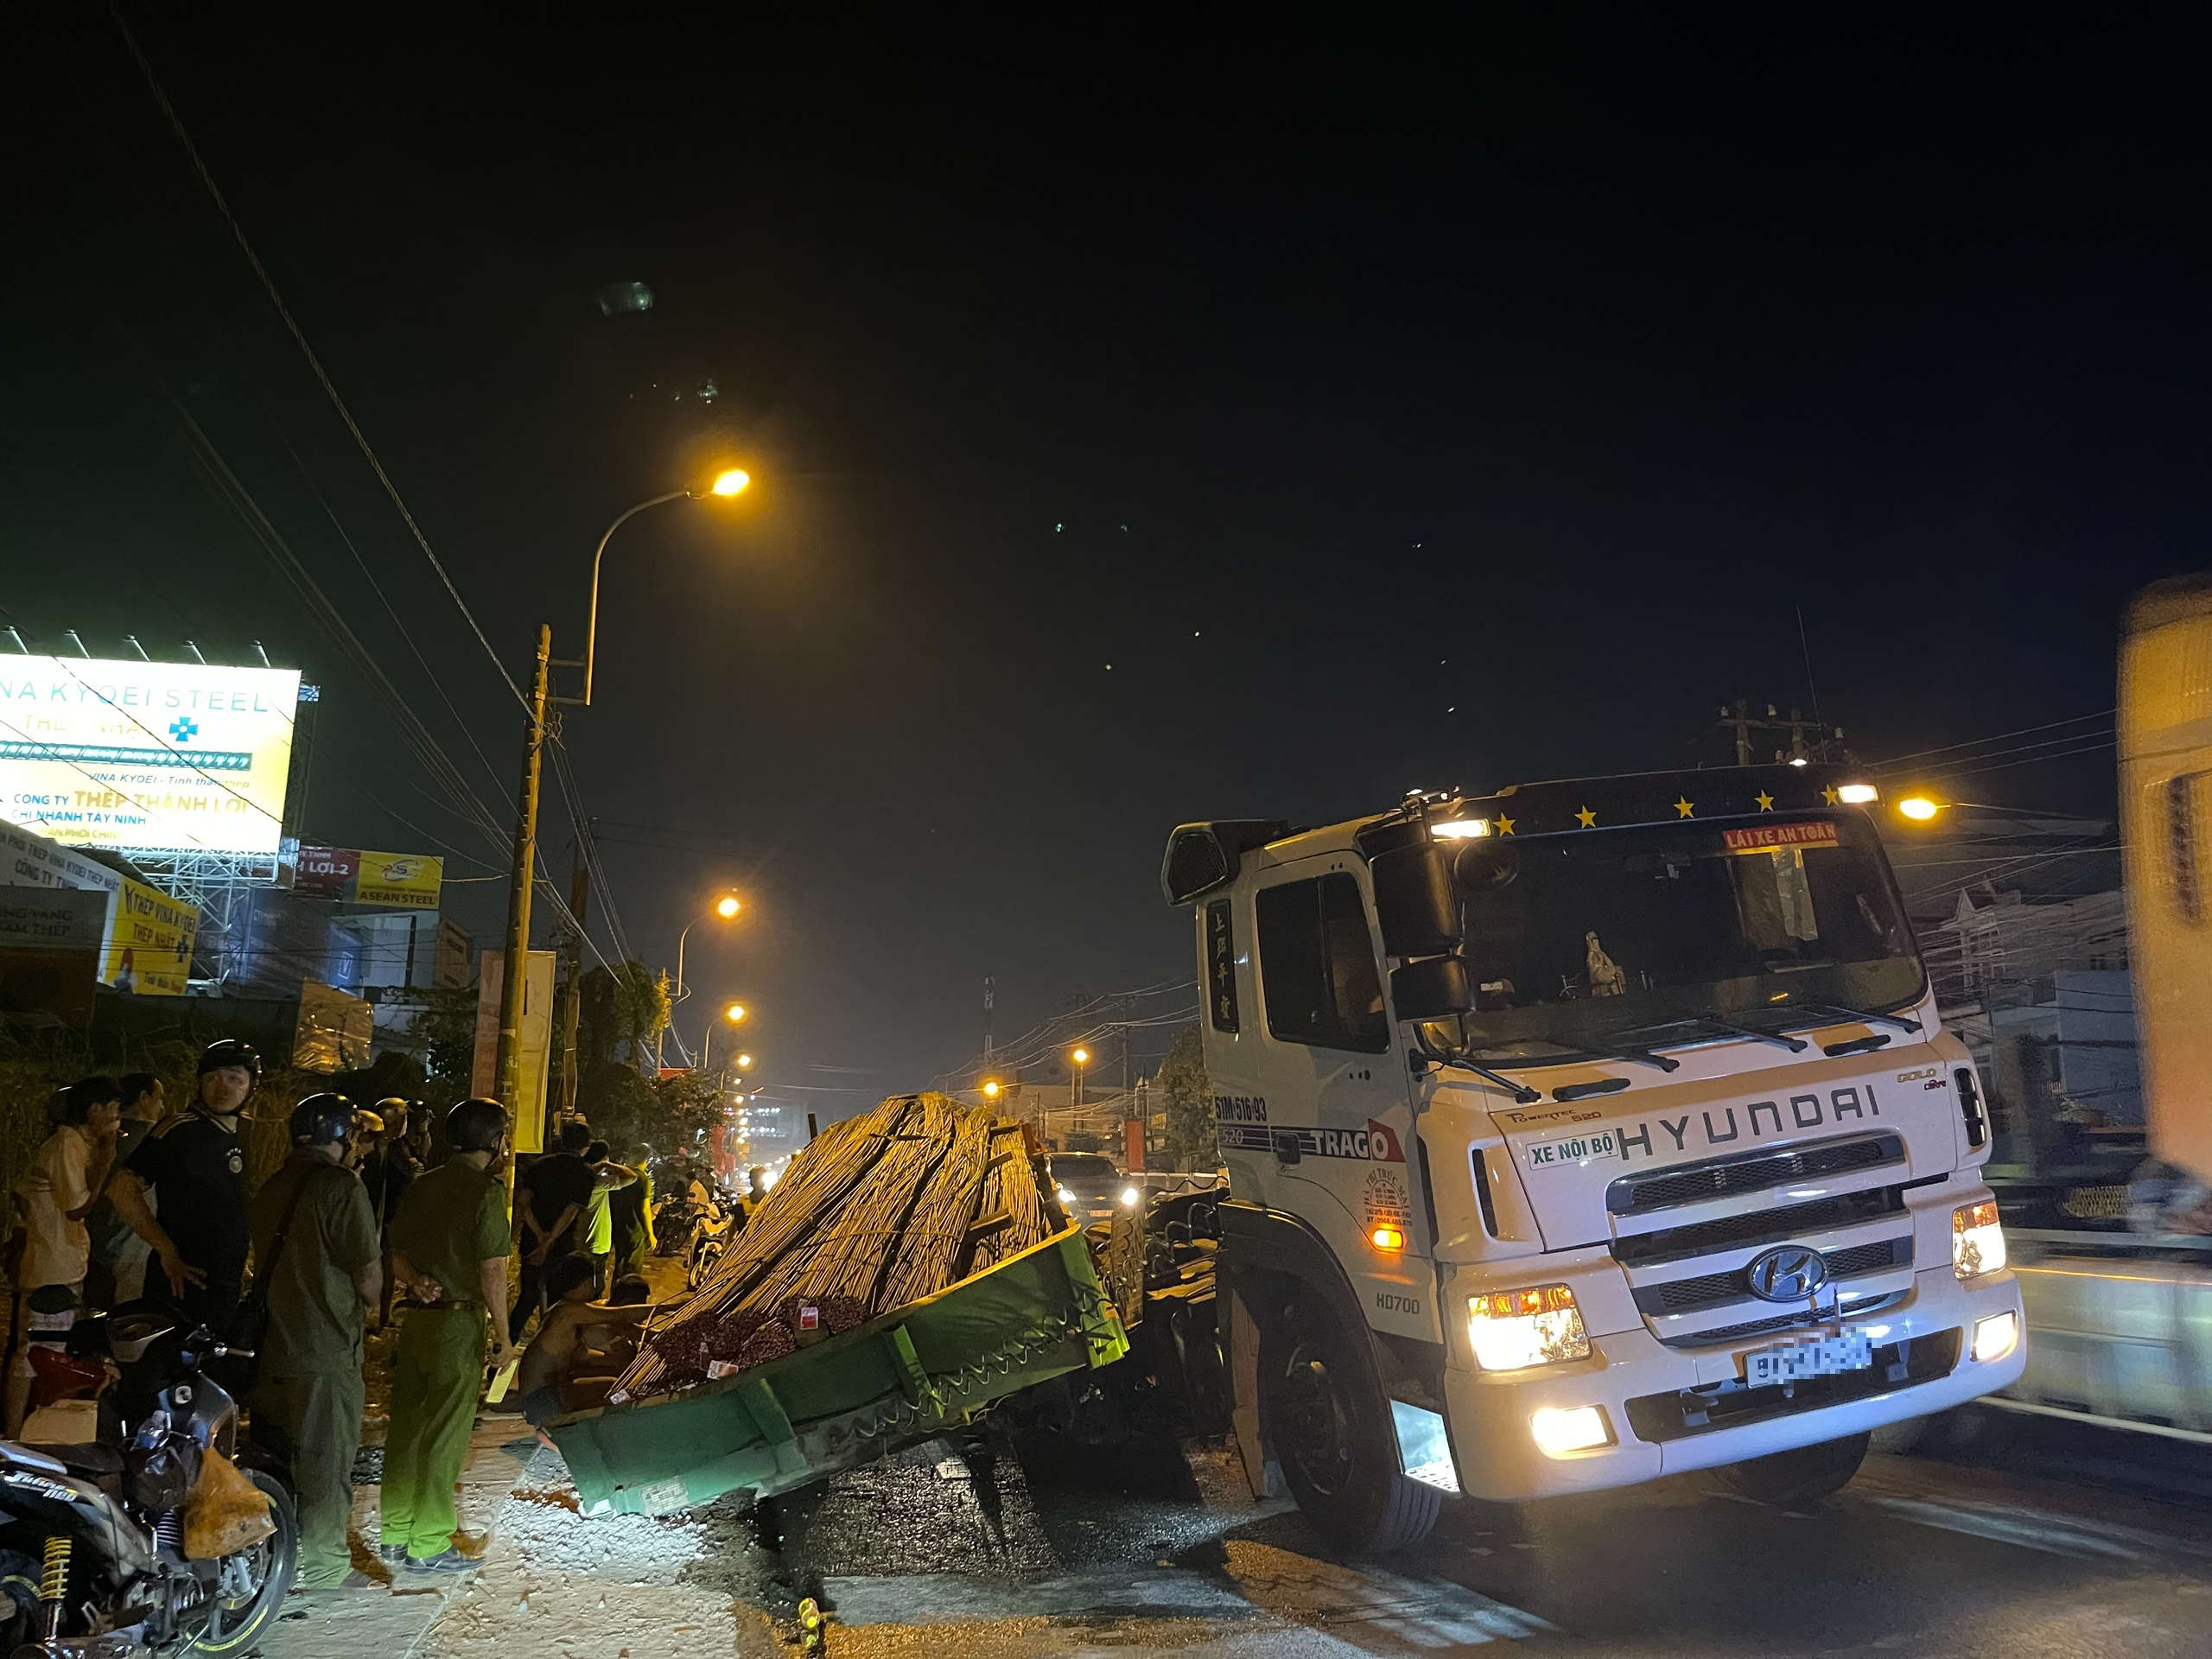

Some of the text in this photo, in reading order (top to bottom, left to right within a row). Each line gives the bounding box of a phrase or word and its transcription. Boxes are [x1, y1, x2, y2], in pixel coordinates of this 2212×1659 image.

[50, 681, 150, 707] KYOEI
[164, 689, 269, 713] STEEL
[89, 772, 117, 783] VINA
[119, 773, 157, 784] KYOEI
[54, 795, 69, 806] TY
[11, 809, 32, 819] CHI
[114, 814, 146, 825] NINH
[1727, 830, 1753, 849] LÁI
[1755, 830, 1776, 845] XE
[1777, 828, 1797, 842] AN
[42, 870, 54, 886] TY
[359, 891, 435, 906] ASEAN STEEL
[1571, 1110, 1602, 1122] 520
[1616, 1084, 1880, 1160] HYUNDAI
[1221, 1128, 1244, 1145] 520
[1309, 1129, 1389, 1160] TRAGO
[1531, 1133, 1613, 1165] XE NỘI BỘ
[1376, 1292, 1420, 1314] HD700
